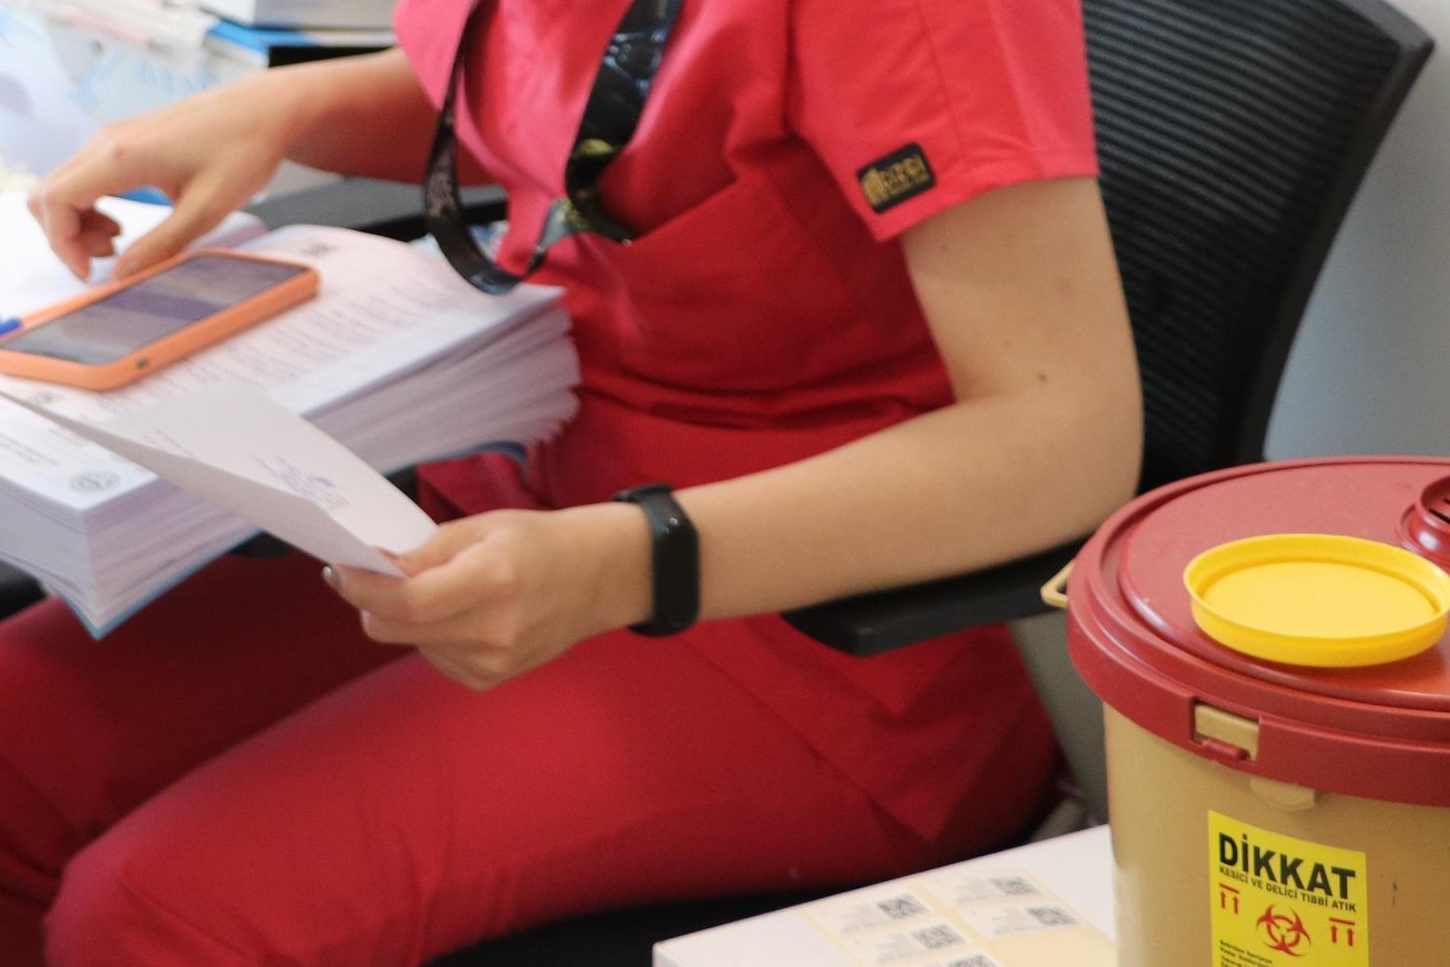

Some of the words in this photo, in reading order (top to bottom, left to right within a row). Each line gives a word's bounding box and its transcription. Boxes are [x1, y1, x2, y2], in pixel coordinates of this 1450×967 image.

[1219, 832, 1356, 900] DİKKAT
[1219, 866, 1248, 883] KESİCİ
[1251, 877, 1263, 889] VE
[1266, 882, 1298, 899] DELİCİ
[1301, 892, 1328, 907] TIBBİ
[1331, 900, 1357, 912] ATIK
